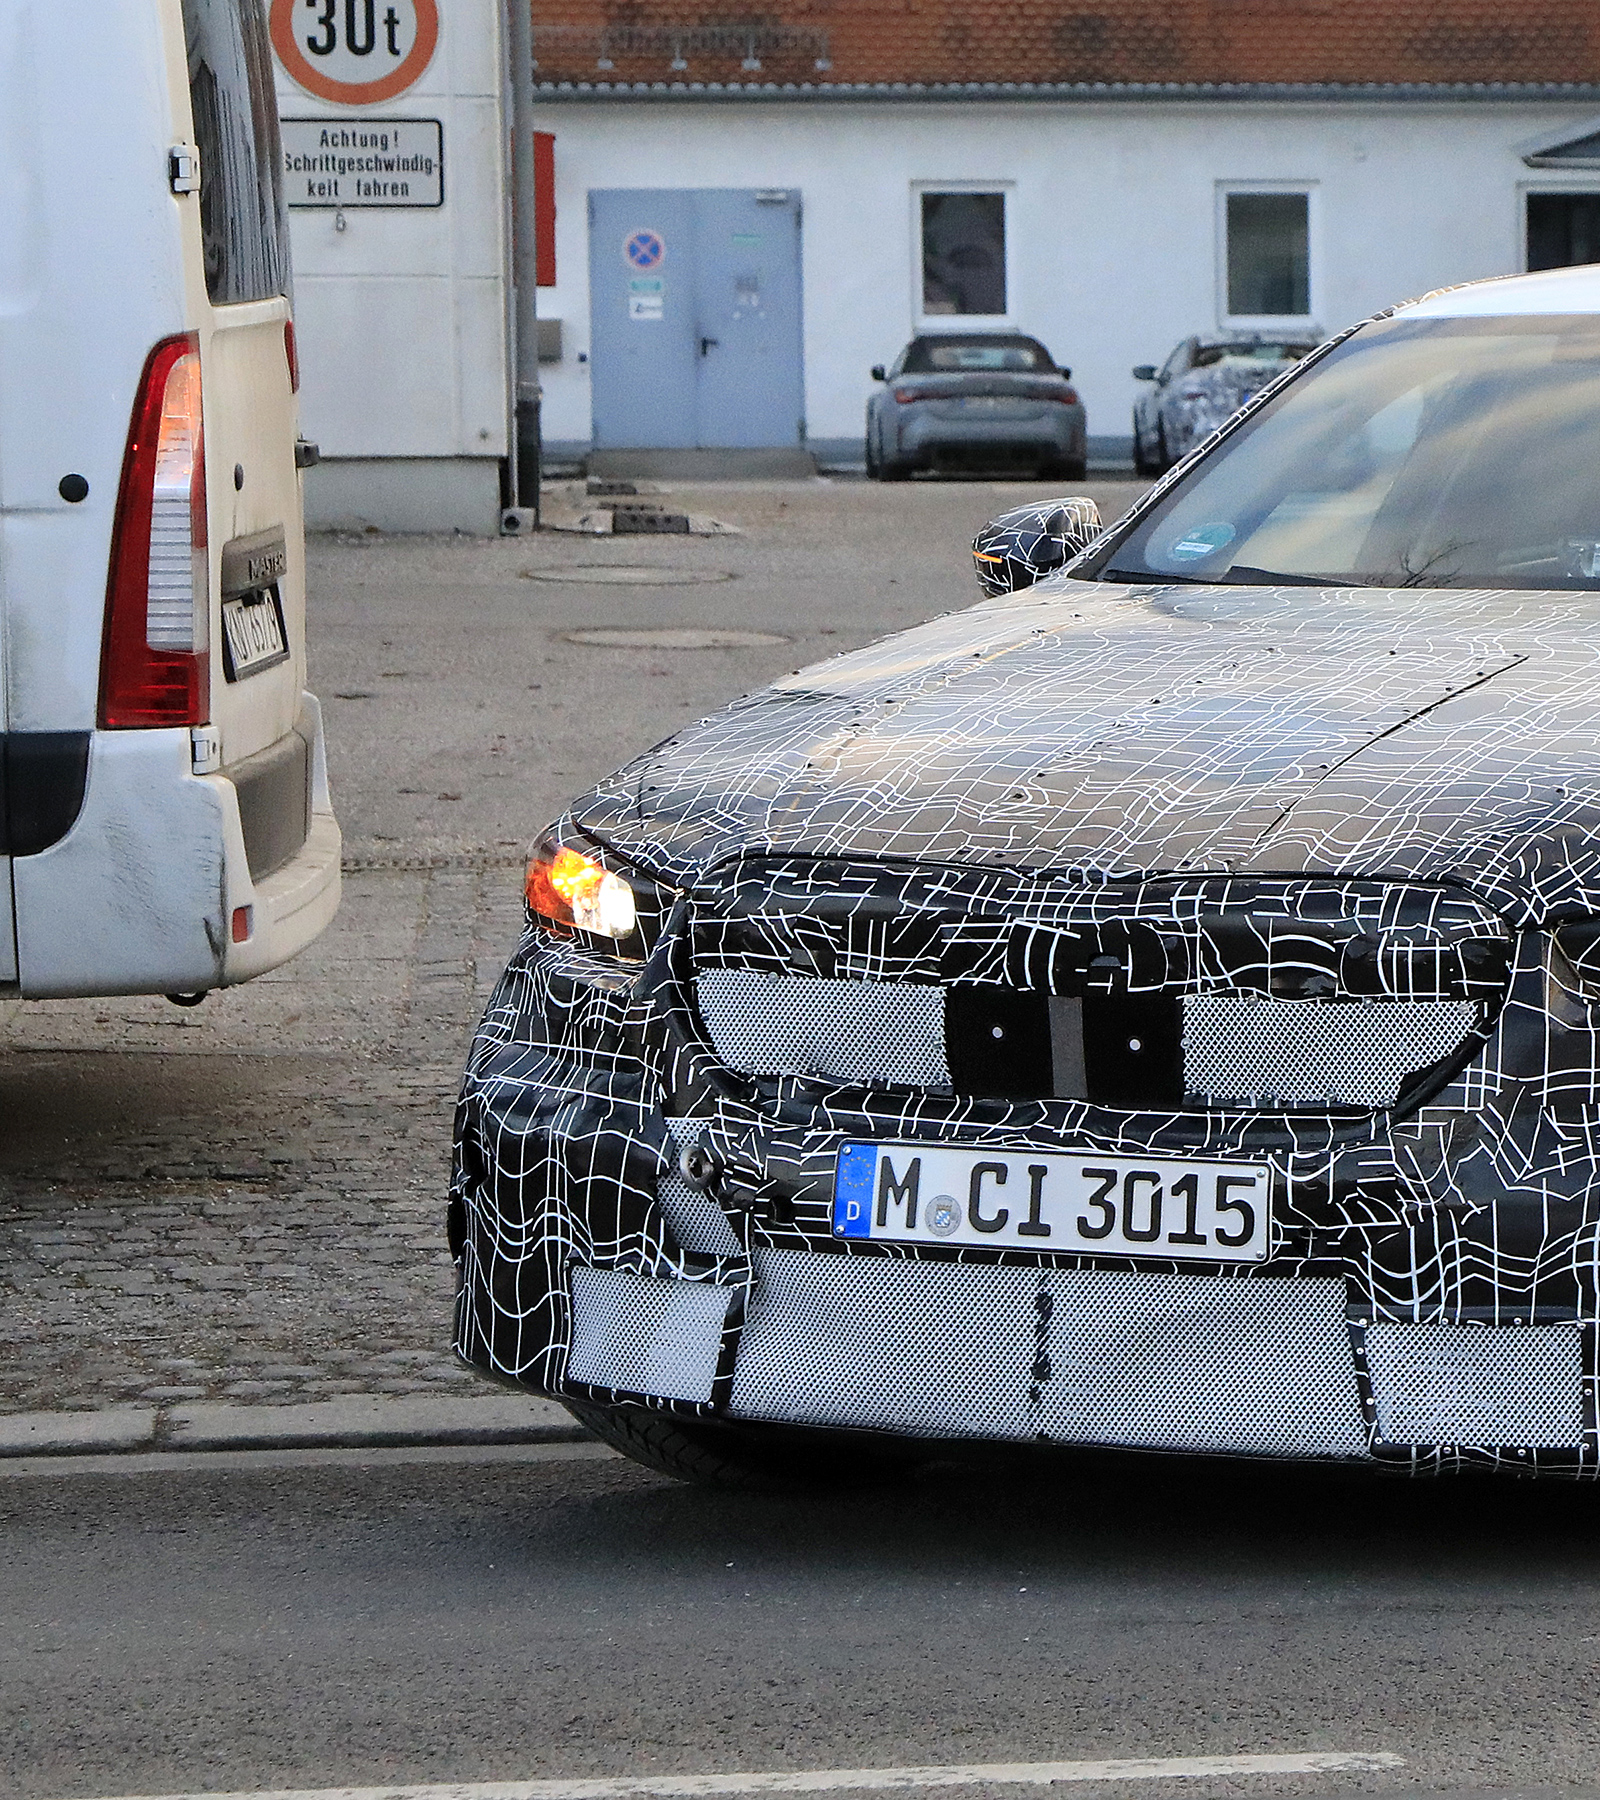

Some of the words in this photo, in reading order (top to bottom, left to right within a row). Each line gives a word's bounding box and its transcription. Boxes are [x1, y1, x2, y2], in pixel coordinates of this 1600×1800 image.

[285, 153, 438, 176] Schrittgeschwindig-
[307, 179, 339, 197] keit
[356, 178, 409, 197] fahren
[846, 1200, 861, 1221] D
[876, 1155, 921, 1229] M
[967, 1160, 1052, 1238] CI
[1076, 1166, 1257, 1248] 3015
